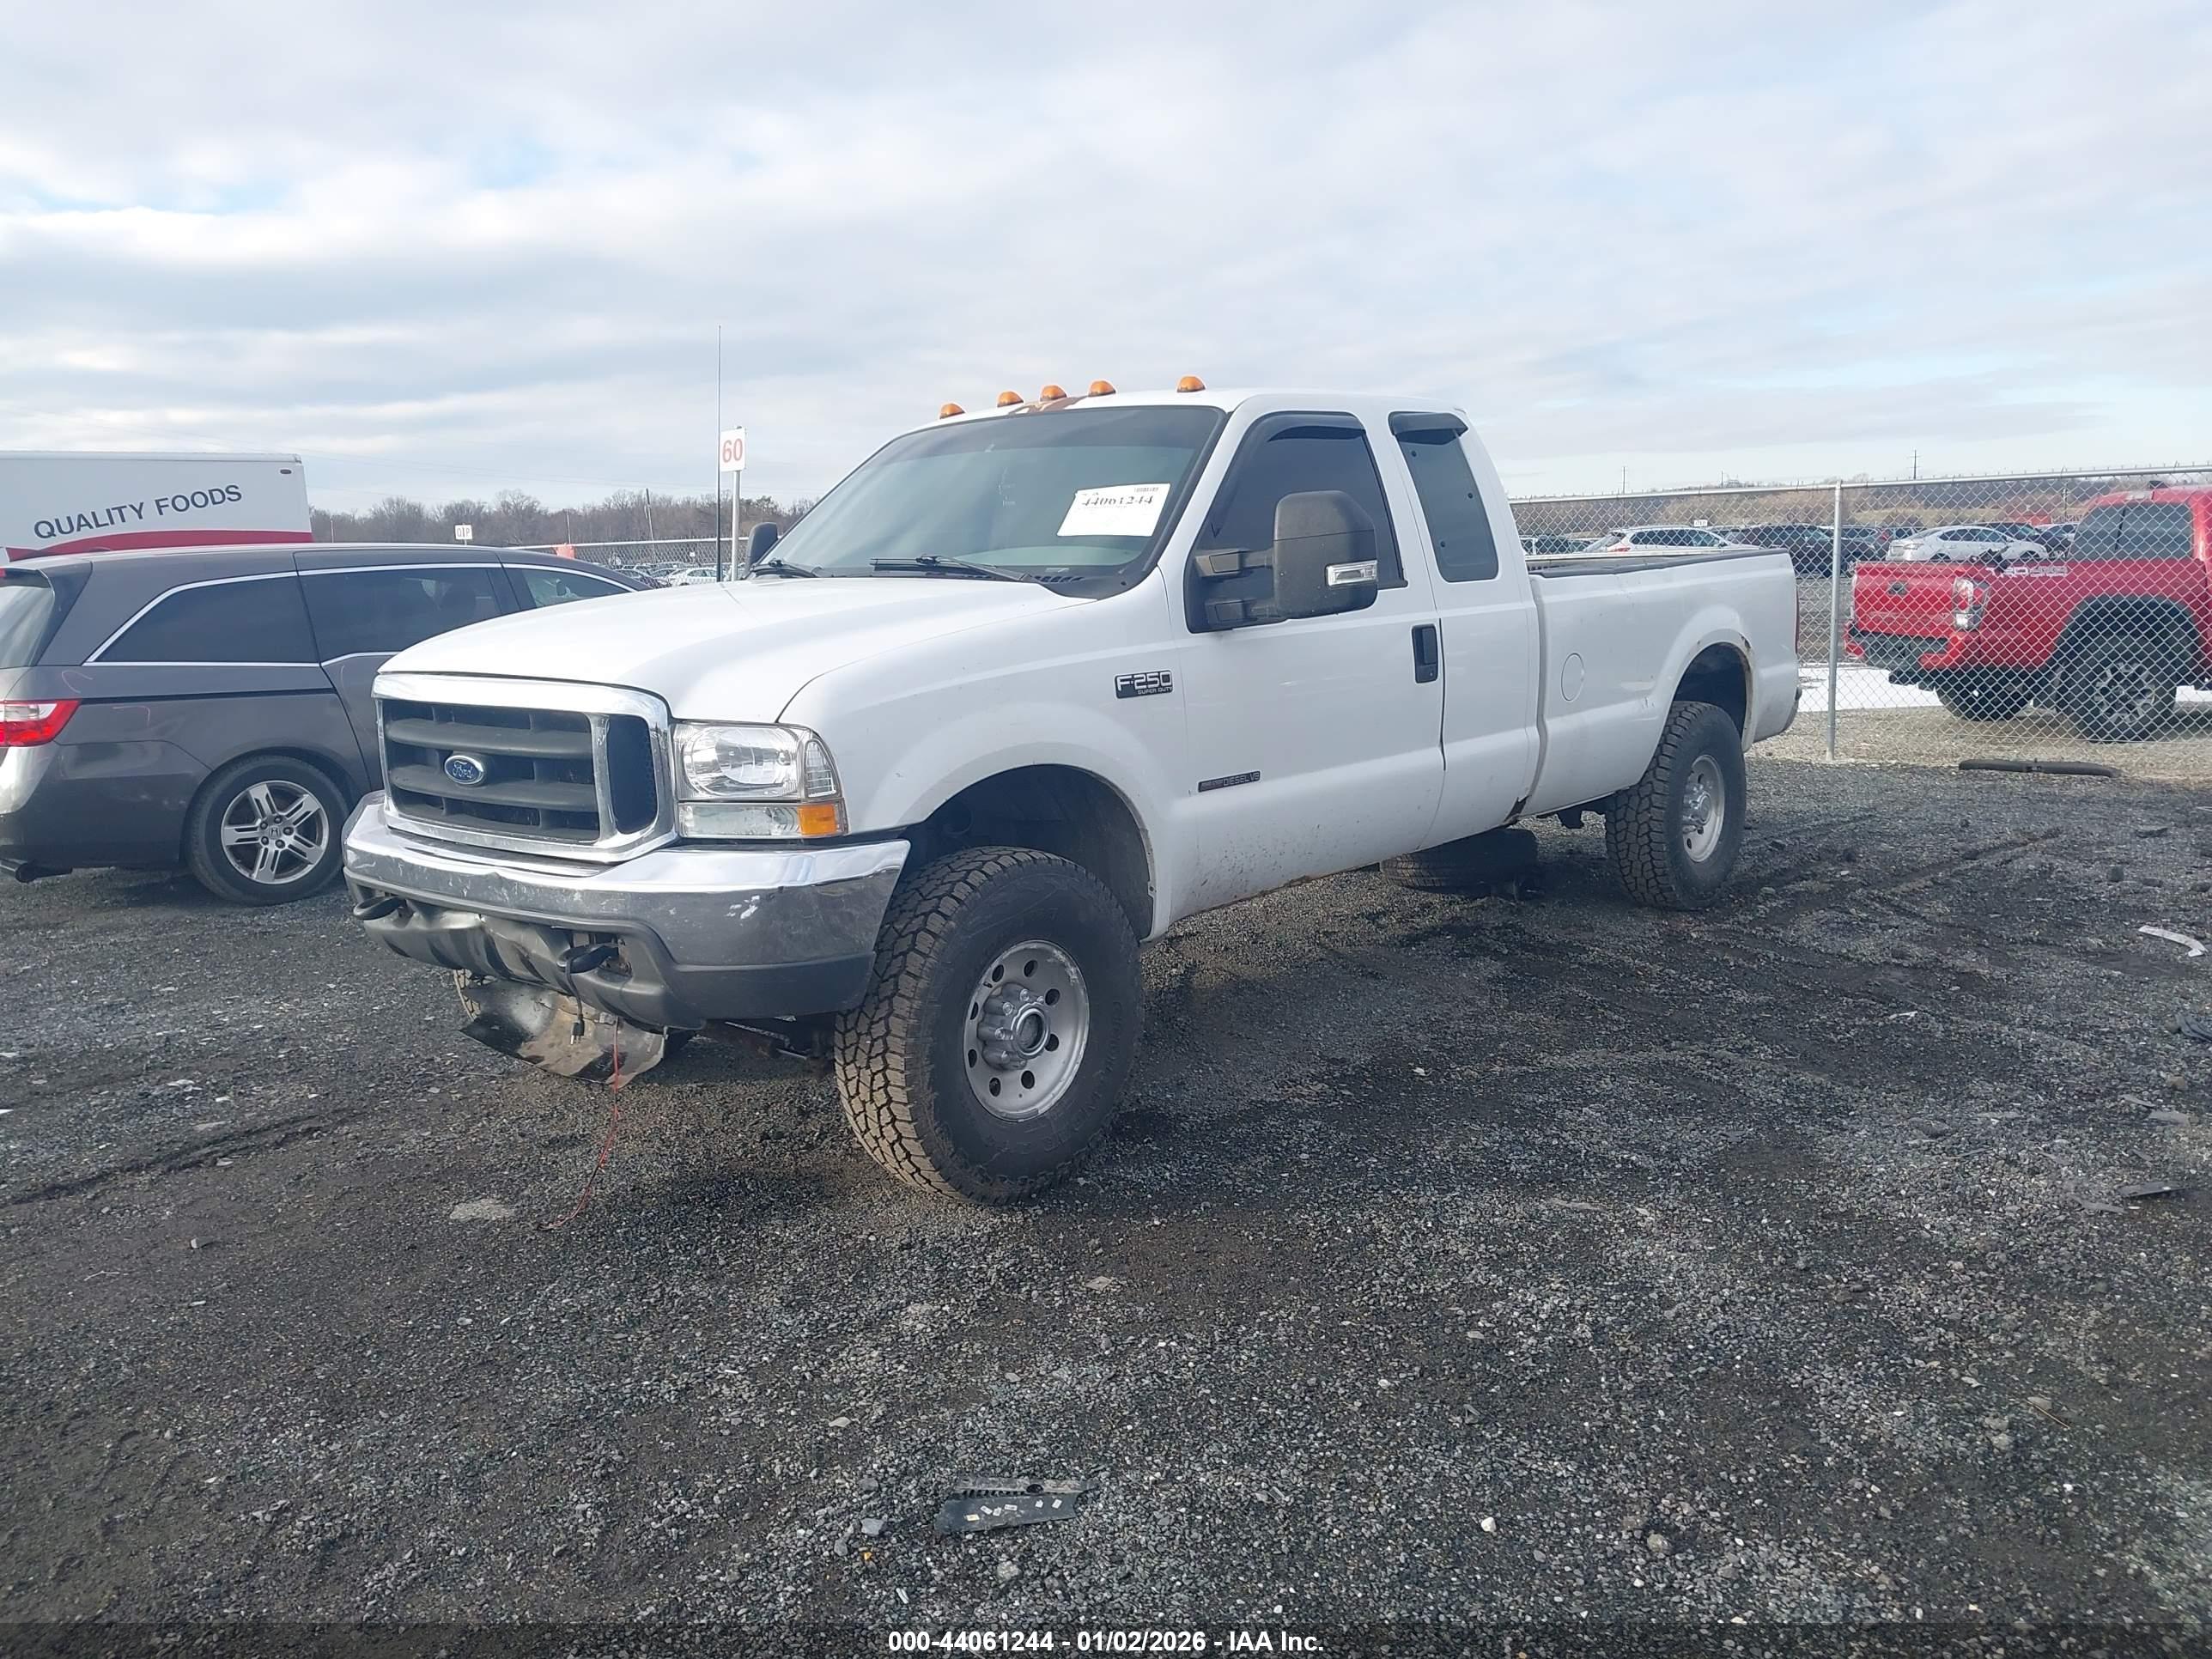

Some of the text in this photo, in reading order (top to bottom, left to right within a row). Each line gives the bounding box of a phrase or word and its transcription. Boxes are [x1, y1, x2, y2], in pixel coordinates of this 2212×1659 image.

[722, 438, 743, 464] 60
[33, 484, 242, 539] QUALITY FOODS
[1116, 672, 1172, 691] F-250
